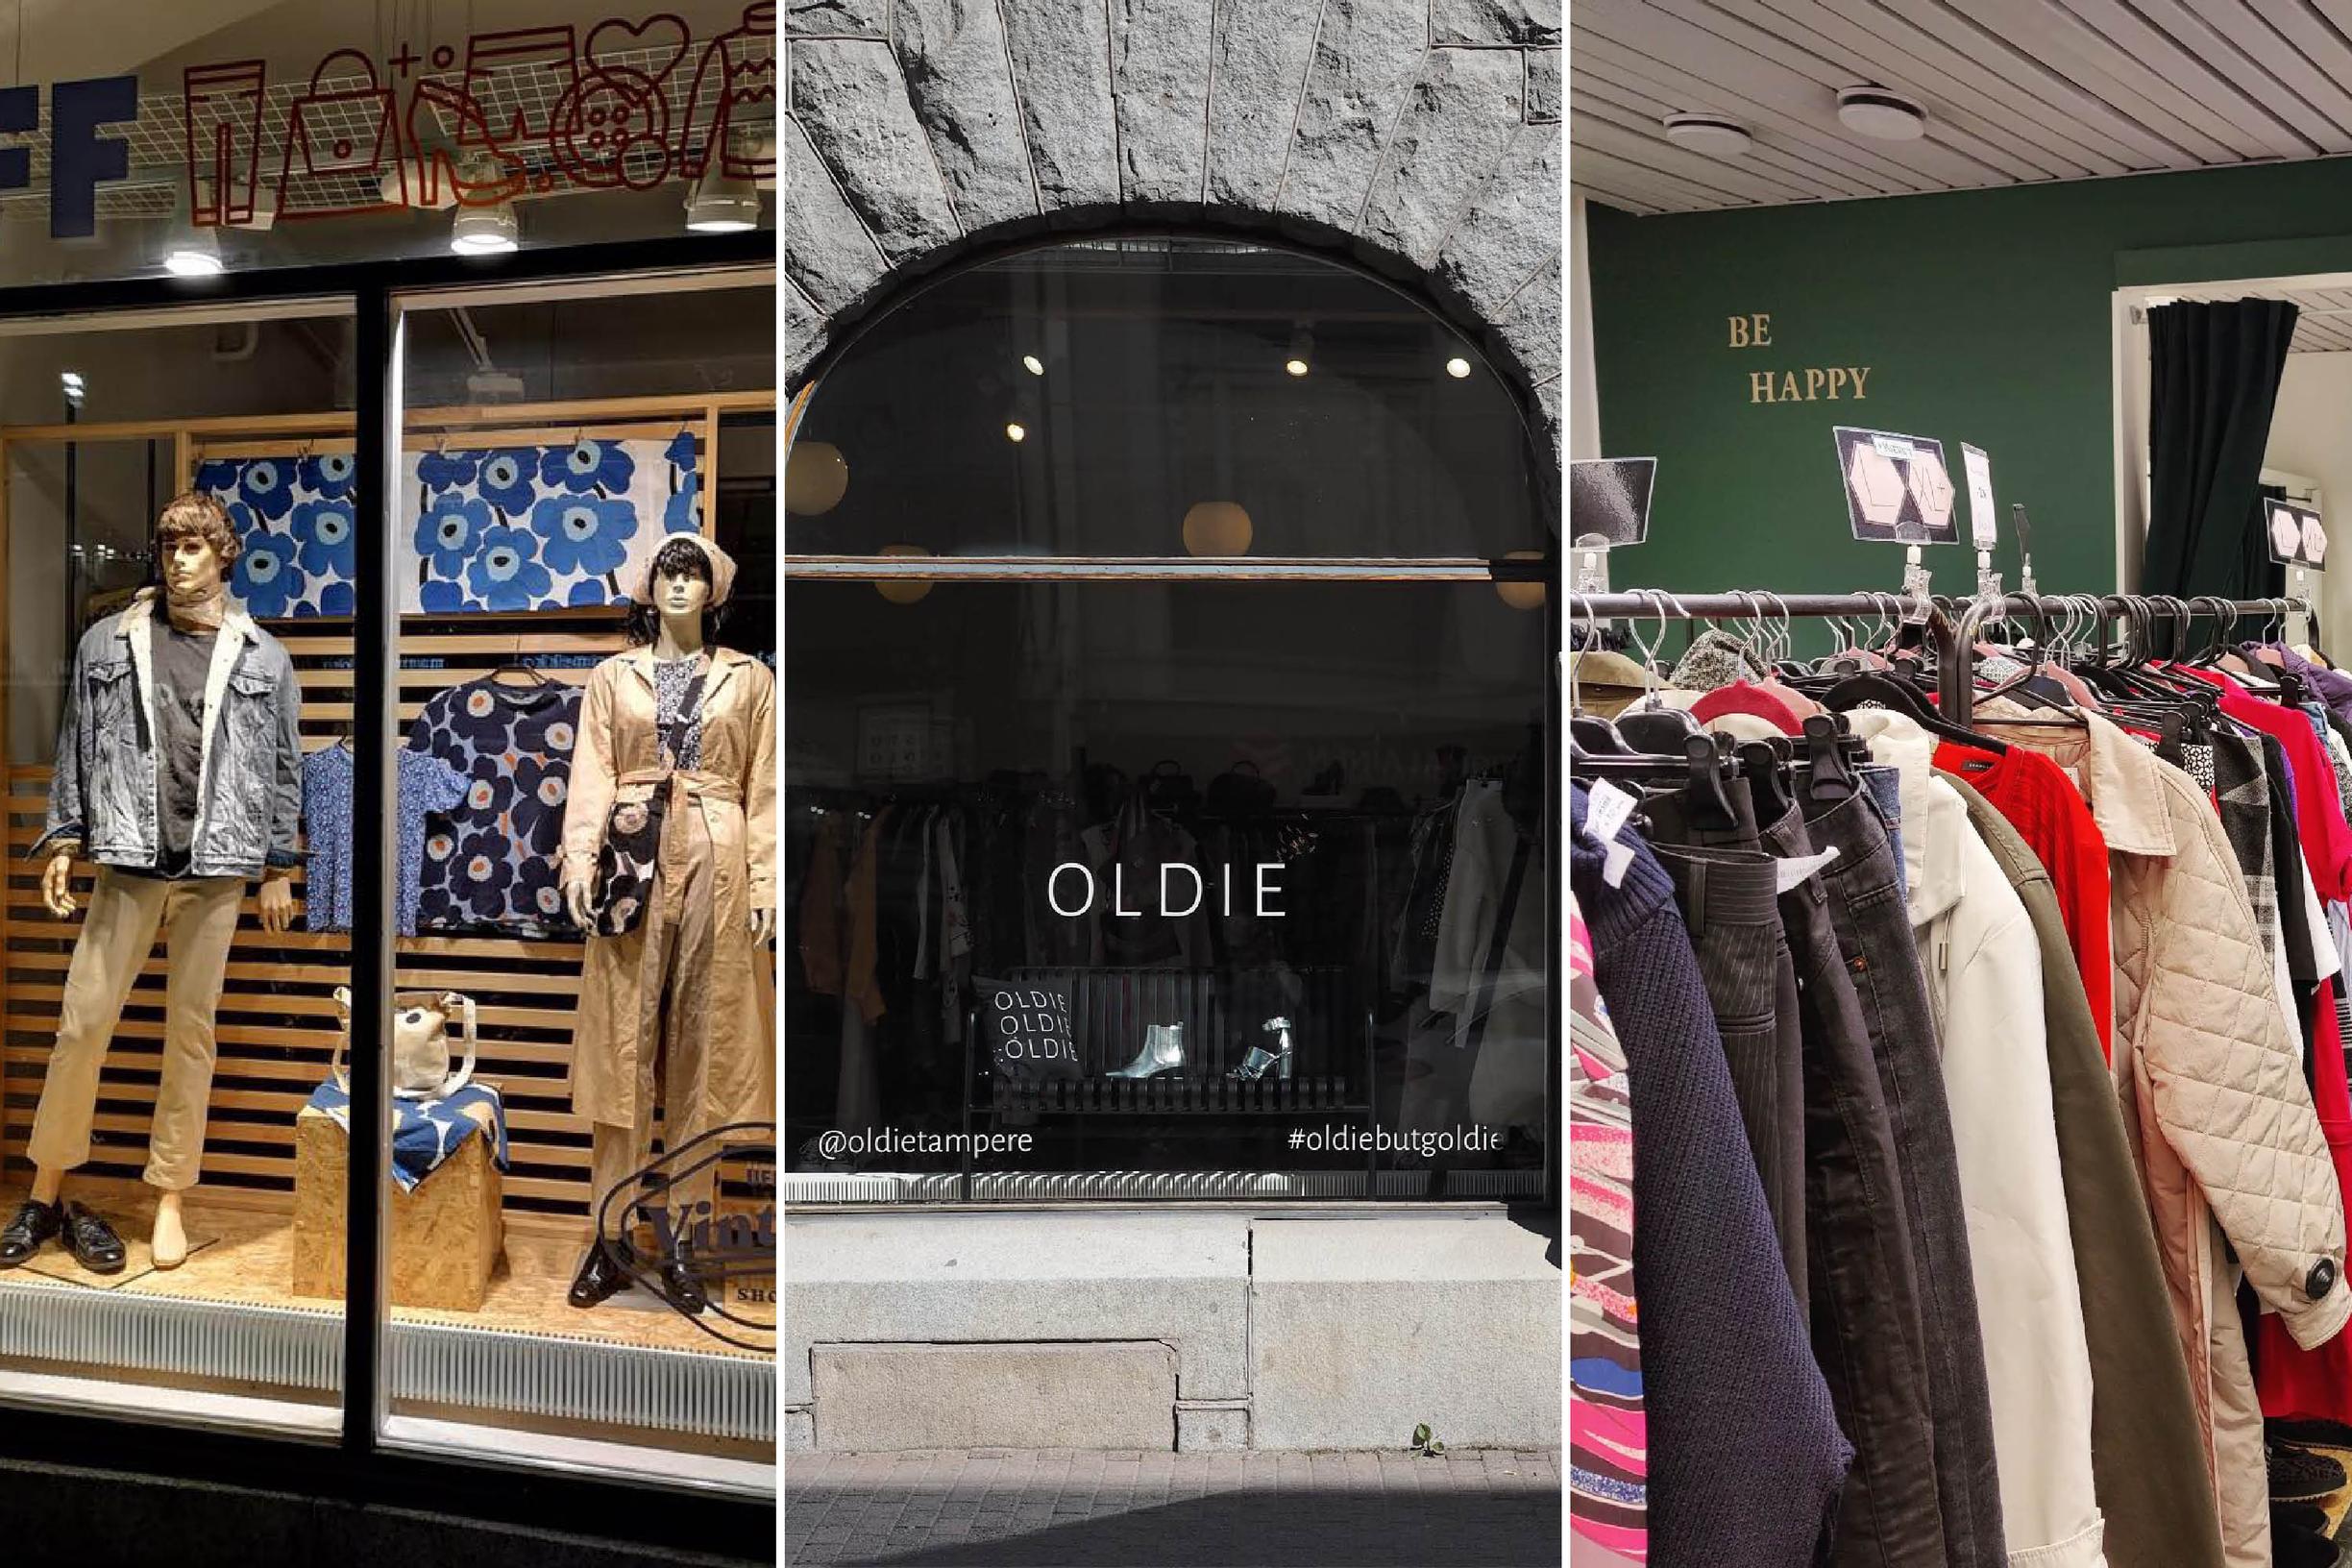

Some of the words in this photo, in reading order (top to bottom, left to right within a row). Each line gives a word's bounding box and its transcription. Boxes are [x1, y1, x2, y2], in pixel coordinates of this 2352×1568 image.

[1727, 313, 1772, 348] BE
[1750, 367, 1872, 404] HAPPY
[1048, 862, 1286, 917] OLDIE
[994, 991, 1067, 1014] OLDIE
[1005, 1039, 1078, 1062] OLDIE
[819, 1126, 1034, 1161] @oldietampere
[1287, 1123, 1506, 1158] #oldiebutgoldie
